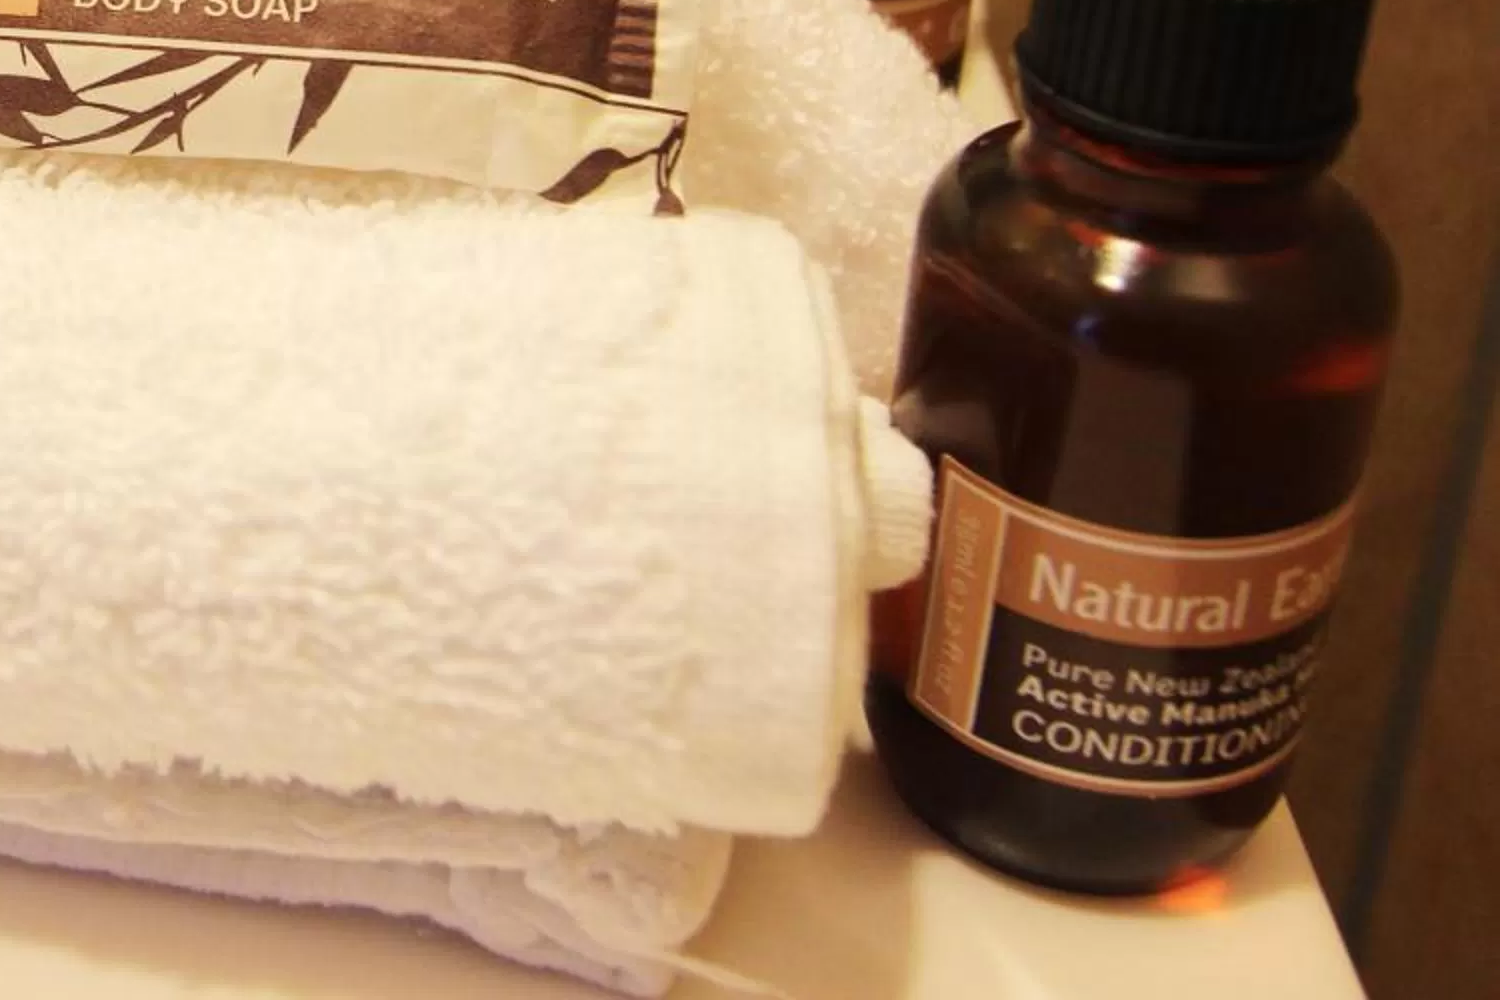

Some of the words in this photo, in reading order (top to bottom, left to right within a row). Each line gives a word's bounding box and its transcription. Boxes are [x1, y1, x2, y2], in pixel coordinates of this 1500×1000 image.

[1029, 553, 1250, 632] Natural
[1022, 641, 1116, 691] Pure
[1124, 668, 1211, 698] New
[1016, 674, 1151, 726] Active
